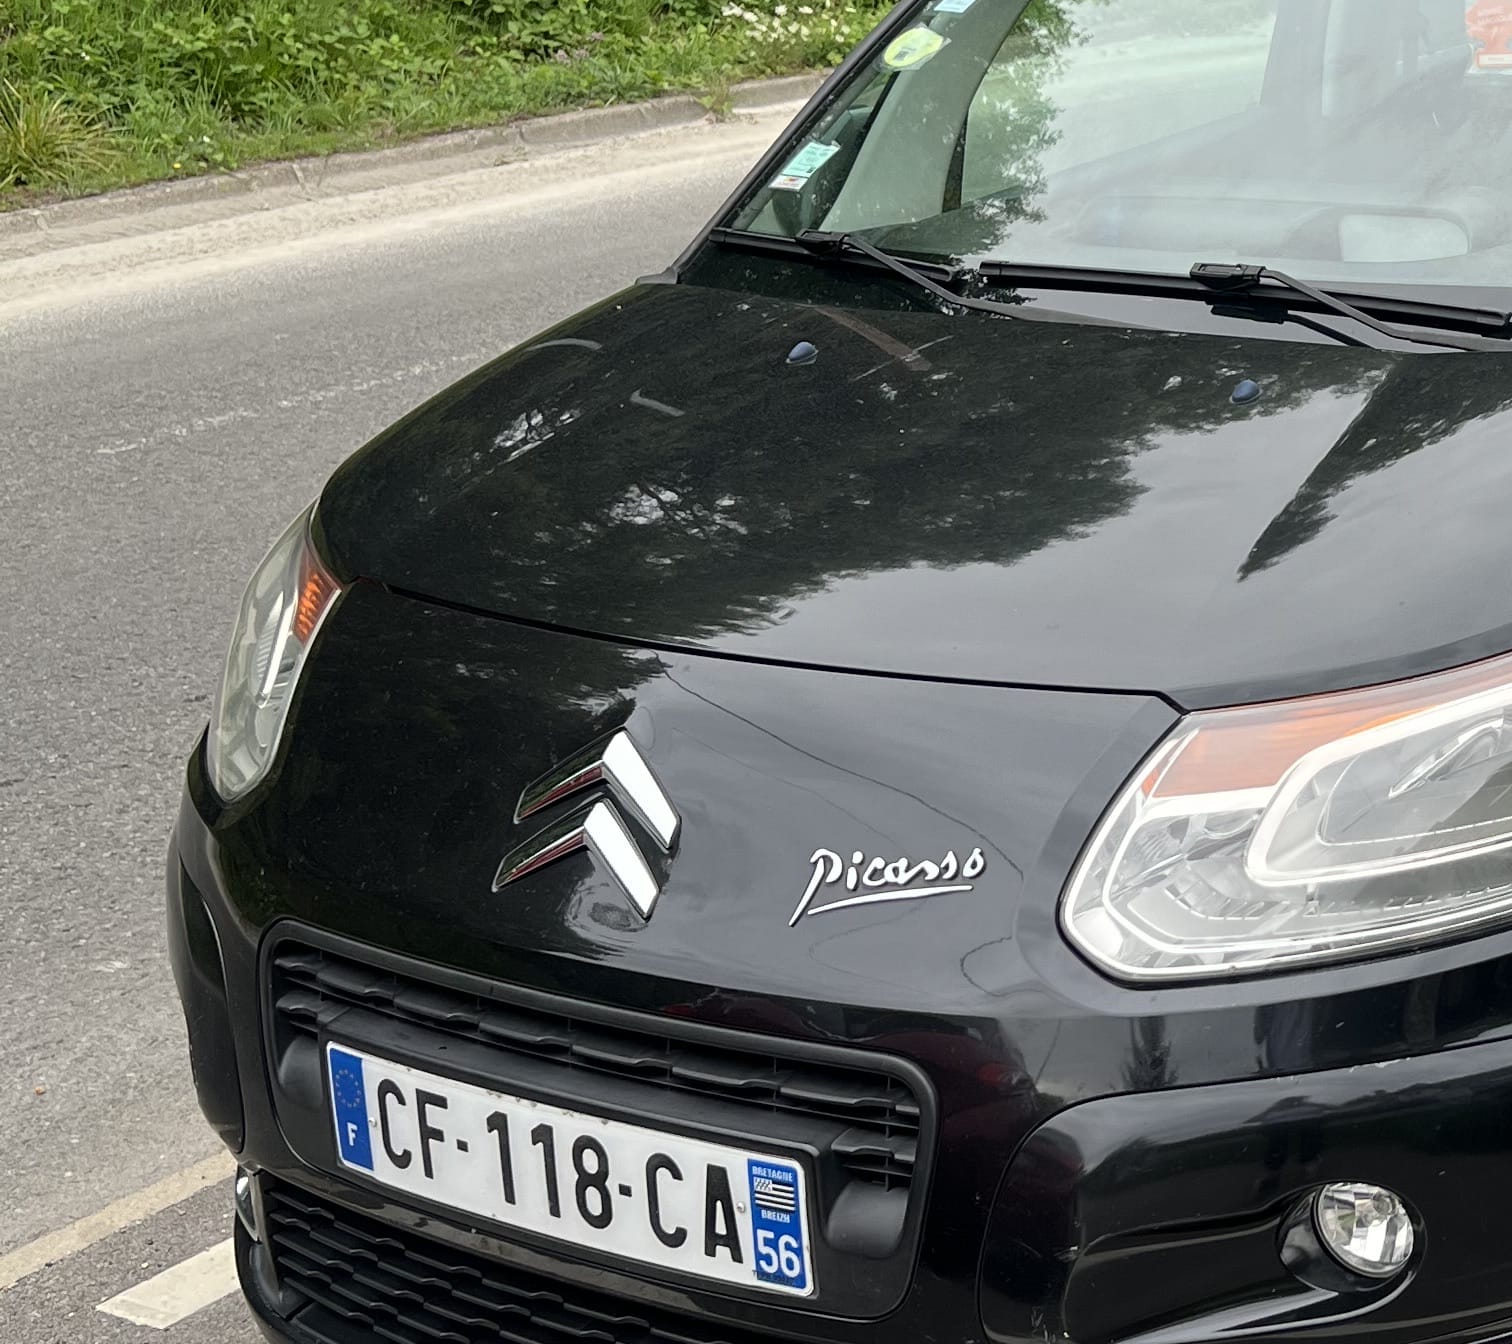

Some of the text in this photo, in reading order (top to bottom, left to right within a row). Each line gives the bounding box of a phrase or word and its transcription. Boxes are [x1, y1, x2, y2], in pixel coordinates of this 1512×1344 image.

[789, 847, 985, 927] Picasso
[346, 1121, 358, 1147] F
[376, 1077, 745, 1265] CF-118-CA
[752, 1166, 793, 1182] BRETAGNE
[761, 1210, 790, 1223] BREIZH
[757, 1229, 800, 1278] 56
